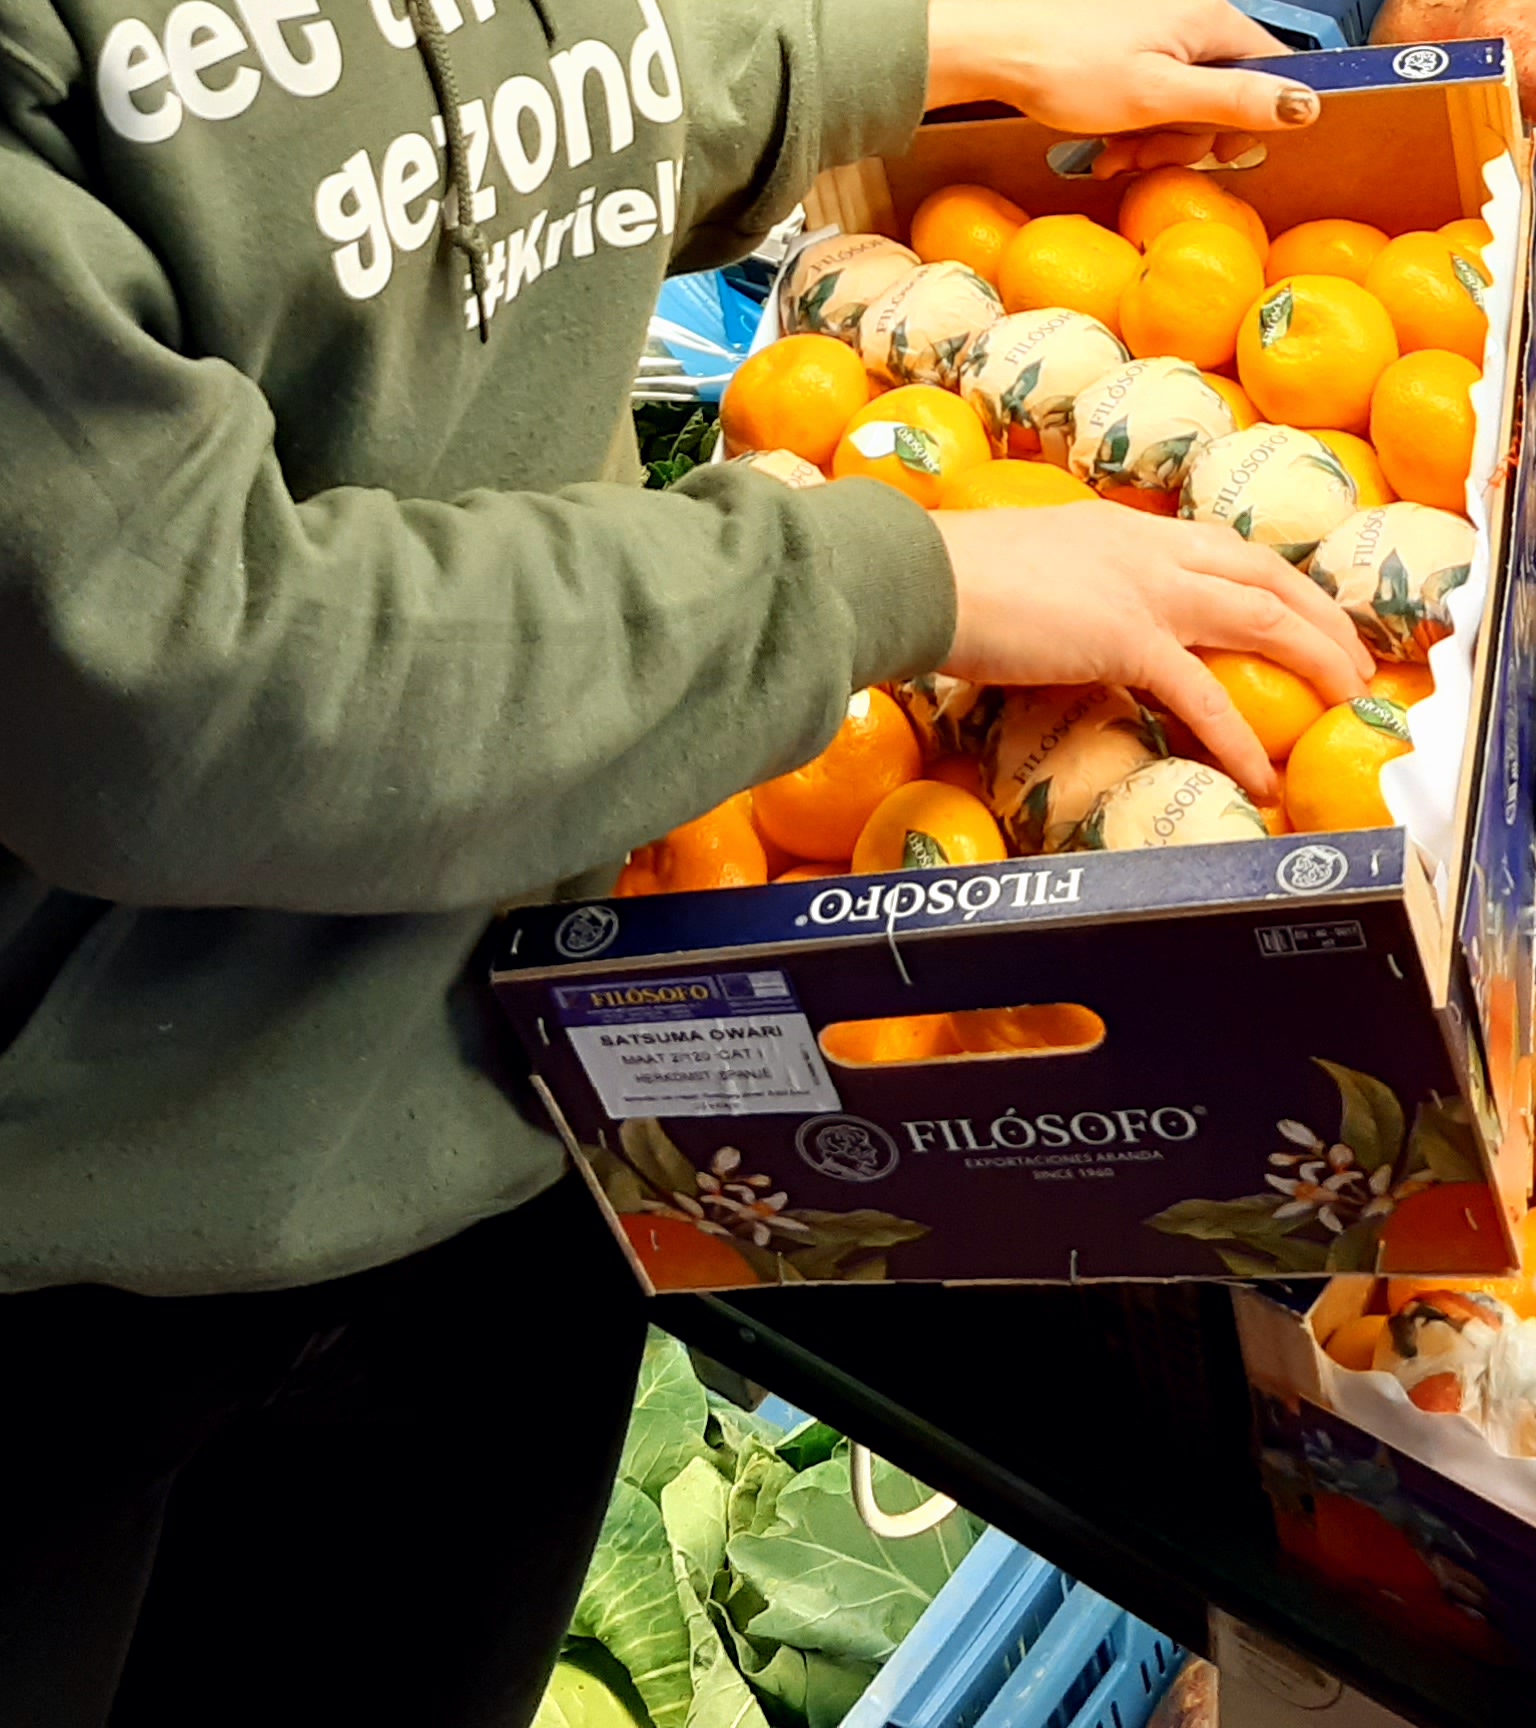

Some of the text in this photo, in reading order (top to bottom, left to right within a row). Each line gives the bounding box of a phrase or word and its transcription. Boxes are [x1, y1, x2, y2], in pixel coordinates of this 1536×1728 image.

[1212, 429, 1289, 521] FILÓSOFO
[808, 865, 1085, 926] FILÓSOFO
[590, 984, 711, 1007] FILÓSOFO
[599, 1024, 784, 1048] SATSUMA OWARI
[901, 1105, 1199, 1155] FILÓSOFO
